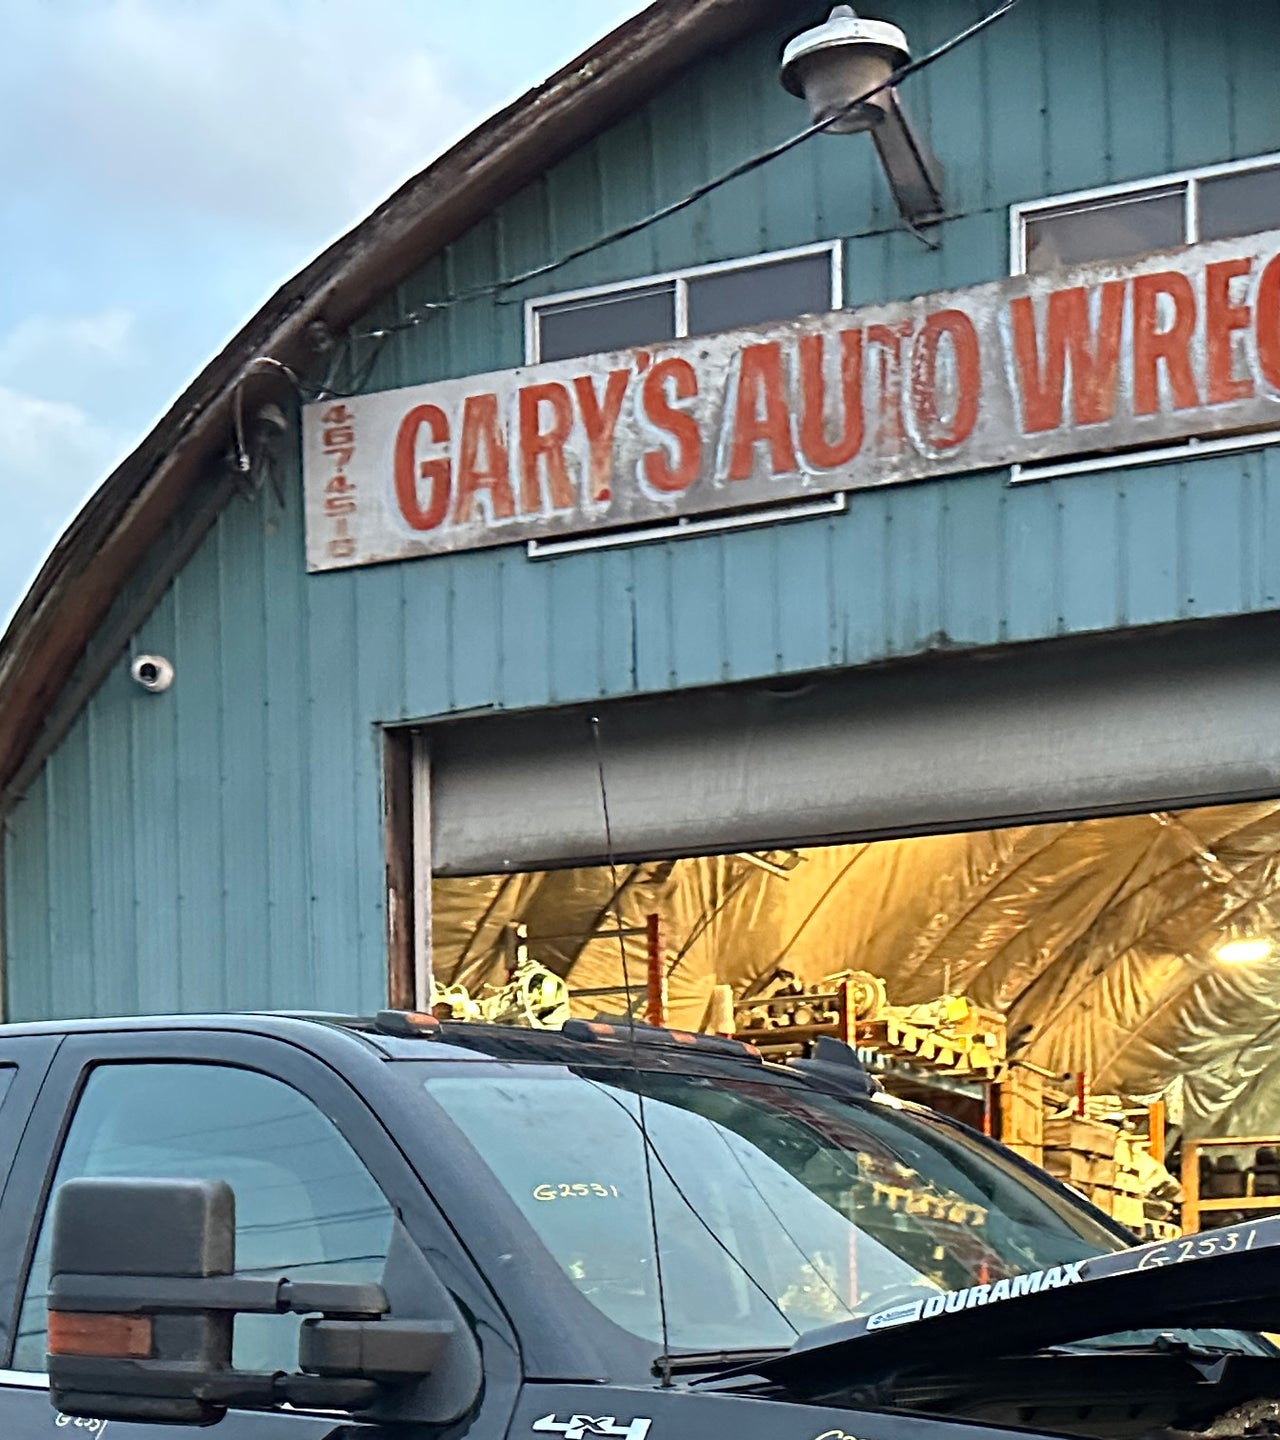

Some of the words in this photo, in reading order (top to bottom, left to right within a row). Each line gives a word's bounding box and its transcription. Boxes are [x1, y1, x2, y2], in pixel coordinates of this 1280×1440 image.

[394, 350, 702, 531] GARY'S
[728, 309, 981, 481] AUTO
[533, 1183, 618, 1201] G2531
[1138, 1229, 1257, 1271] G2531
[923, 1261, 1088, 1319] DURAMAX
